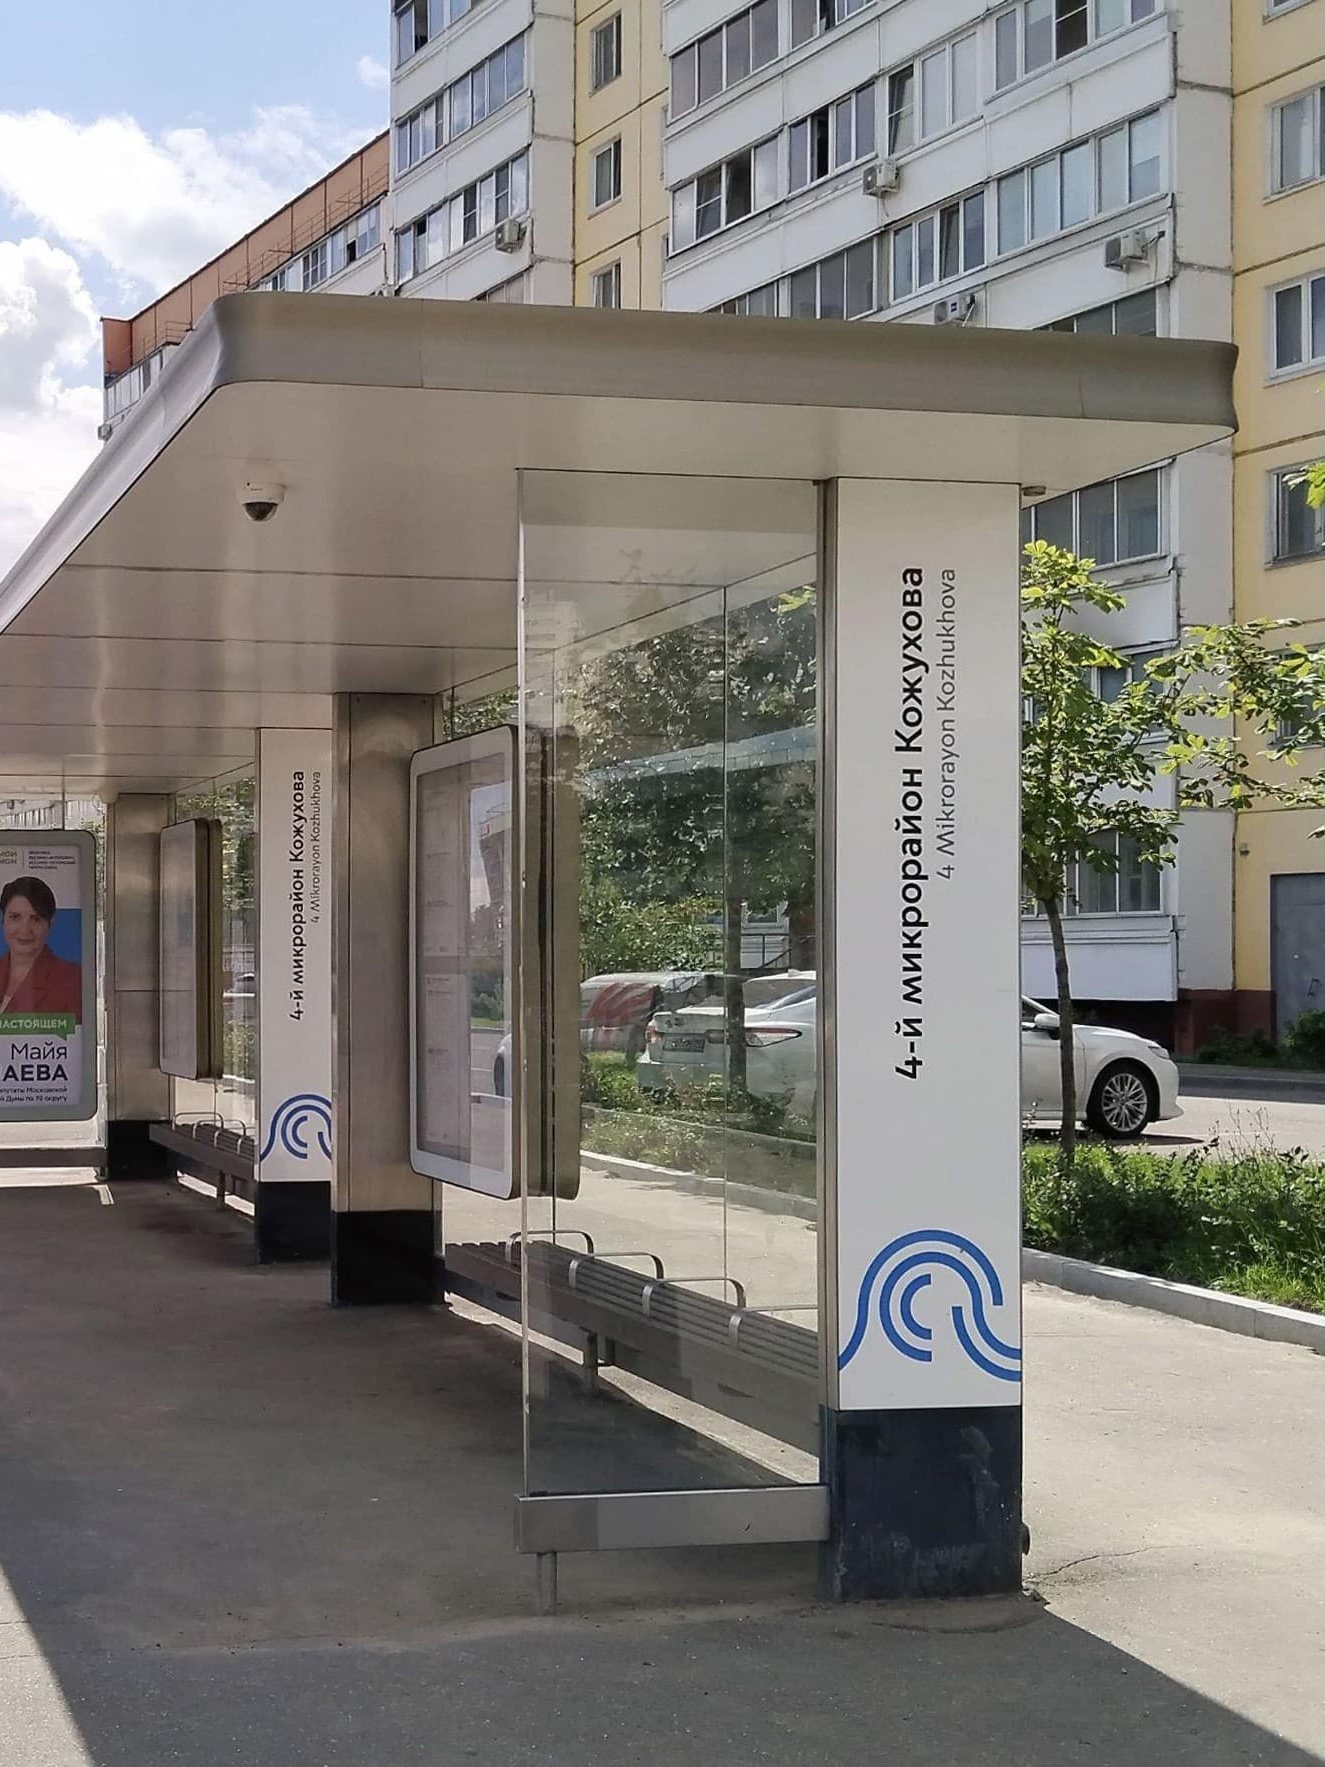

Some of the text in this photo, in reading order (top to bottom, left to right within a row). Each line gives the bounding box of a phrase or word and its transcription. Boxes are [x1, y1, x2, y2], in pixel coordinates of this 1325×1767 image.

[309, 771, 323, 924] 4 Mikrorayon Kozhukhova
[894, 567, 930, 1080] 4-й микрорайон Кожухова
[934, 567, 961, 880] 4 Mikrorayon Kozhukhova
[289, 771, 308, 1021] 4-й микрорайон Кожухова
[11, 1041, 67, 1060] Майя
